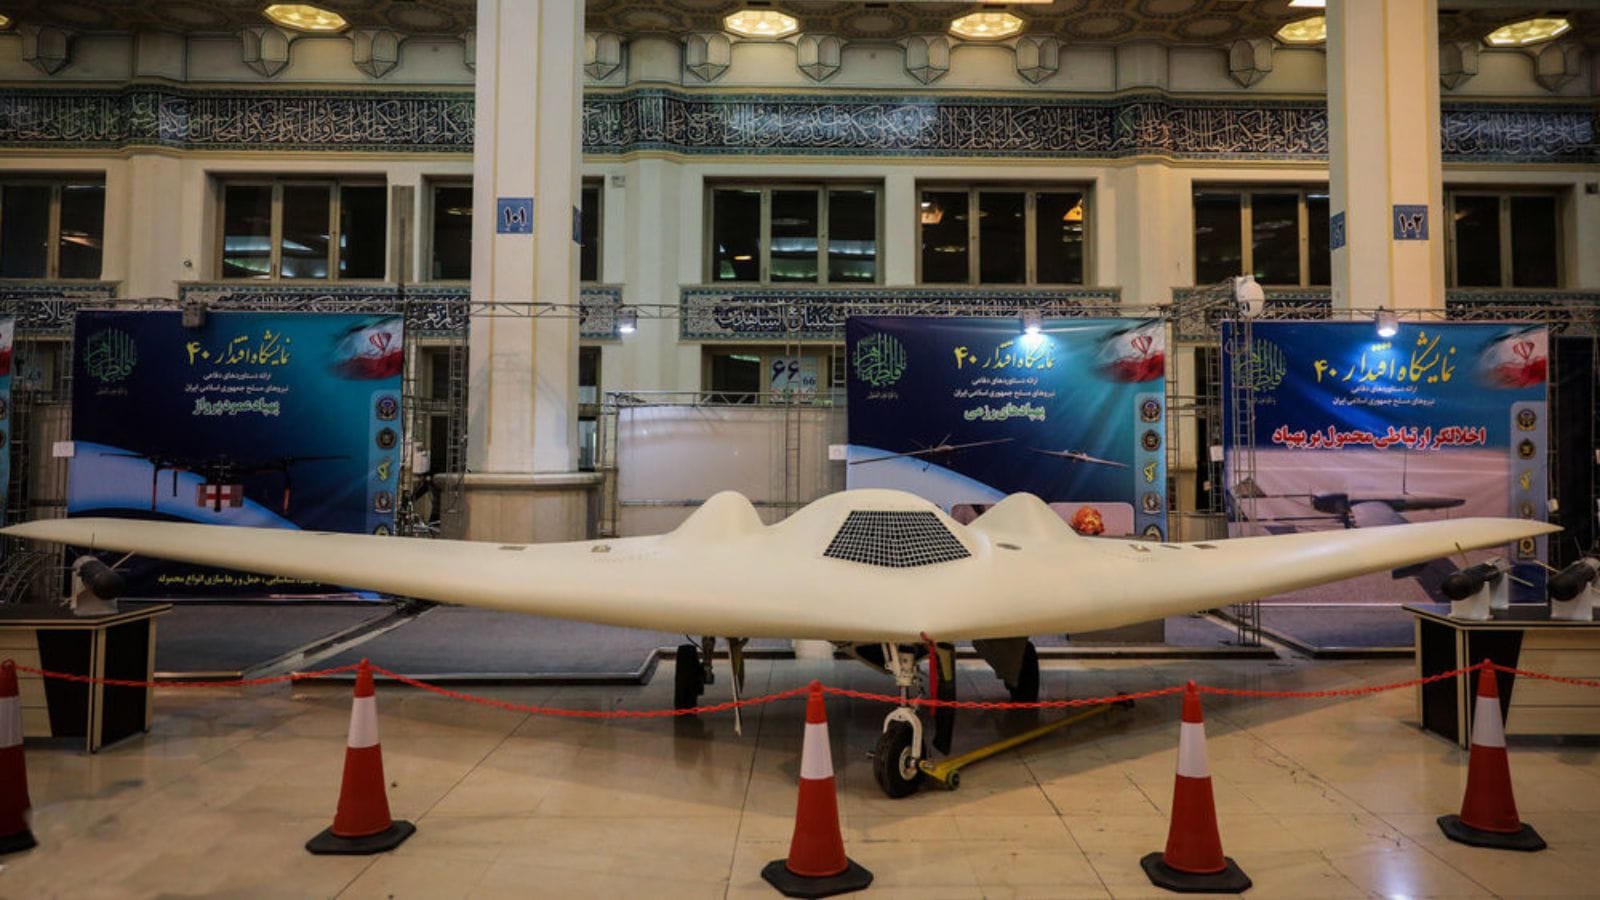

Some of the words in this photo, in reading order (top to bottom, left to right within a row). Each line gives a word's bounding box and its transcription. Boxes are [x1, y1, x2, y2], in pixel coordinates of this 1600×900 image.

[186, 341, 210, 365] ۴۰
[214, 336, 250, 365] اقتدار
[251, 330, 291, 365] نمایشگاه
[953, 346, 978, 369] ۴۰
[982, 340, 1017, 369] اقتدار
[1397, 331, 1457, 383] نمایشگاه
[1313, 359, 1338, 383] ۴۰
[1342, 341, 1396, 382] اقتدار
[1272, 424, 1307, 451] پهپاد
[1306, 429, 1322, 449] بر
[1322, 424, 1373, 449] محمول
